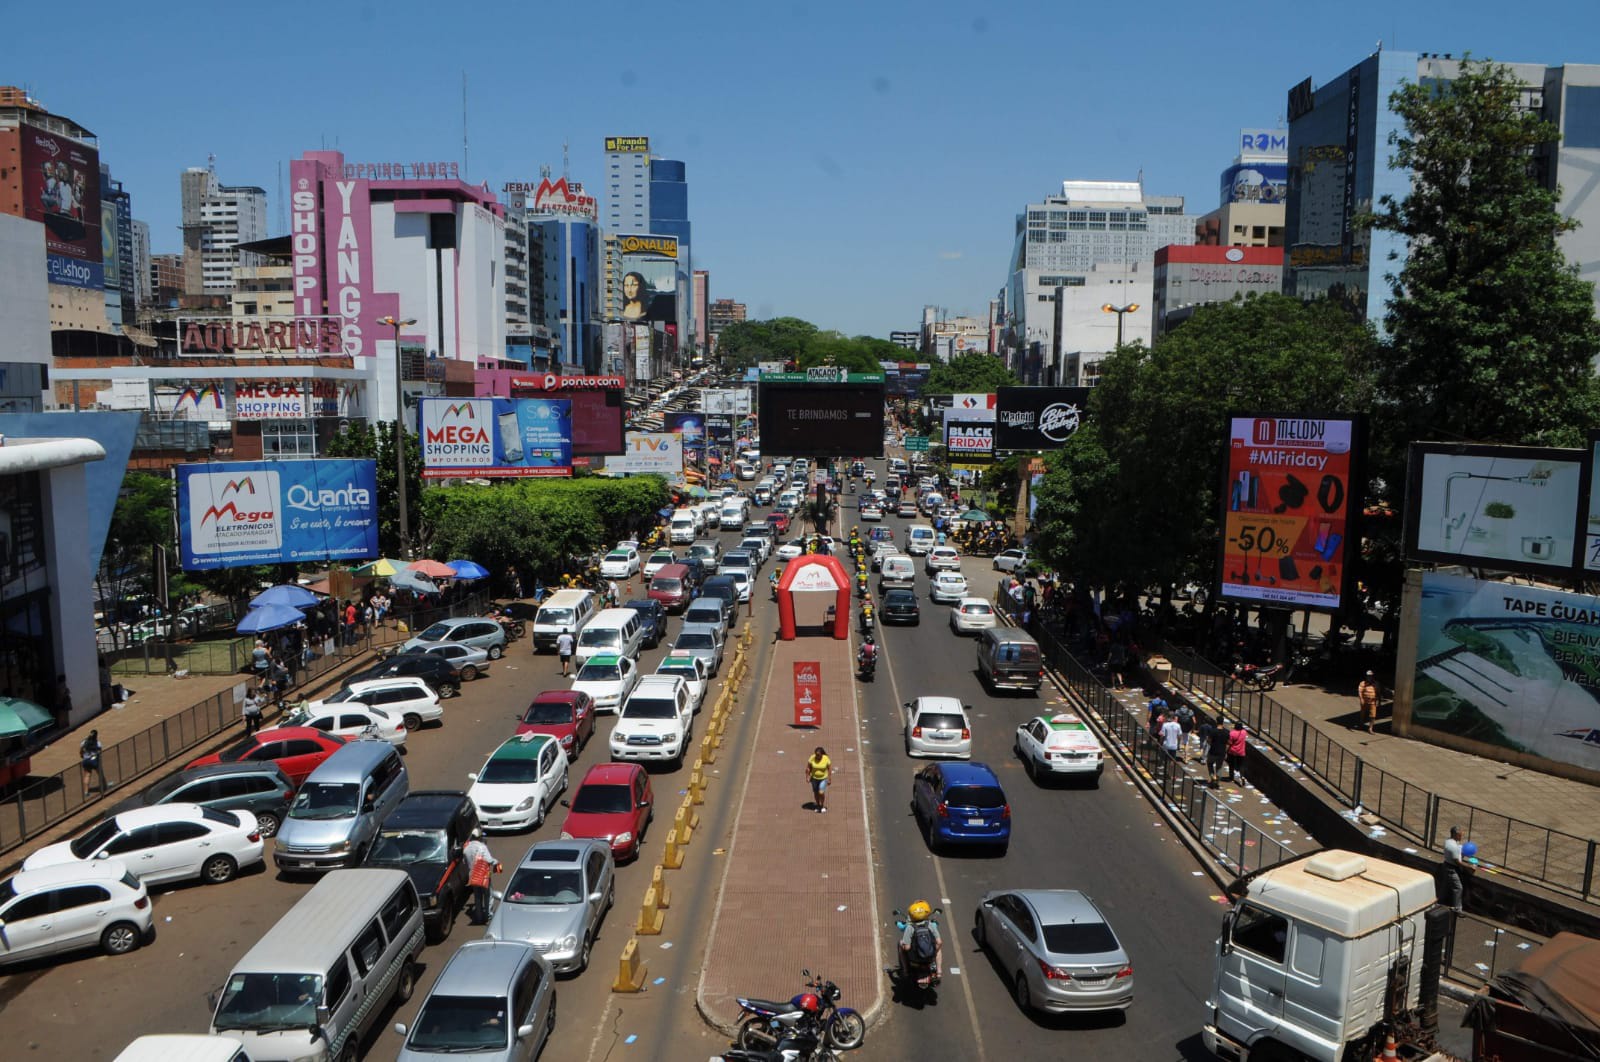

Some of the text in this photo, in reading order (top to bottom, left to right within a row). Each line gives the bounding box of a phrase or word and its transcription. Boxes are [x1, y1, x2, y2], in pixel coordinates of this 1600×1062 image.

[617, 137, 646, 145] Brands
[336, 181, 363, 357] YANG'S
[1190, 267, 1232, 286] Digital
[183, 319, 344, 351] AQUARIUS
[235, 382, 301, 398] MEGA
[237, 402, 301, 413] SHOPPING
[527, 405, 561, 420] SOS
[787, 409, 848, 420] TE BRINDAMOS
[1000, 410, 1035, 423] Madrid
[426, 426, 490, 444] MEGA
[949, 427, 993, 437] BLACK
[1278, 420, 1325, 440] MELODY
[427, 444, 491, 455] SHOPPING
[949, 437, 992, 448] FRIDAY
[1249, 450, 1328, 471] #MiFriday
[286, 483, 370, 511] Quanta
[200, 501, 274, 528] Mega
[1503, 597, 1547, 616] TAPE
